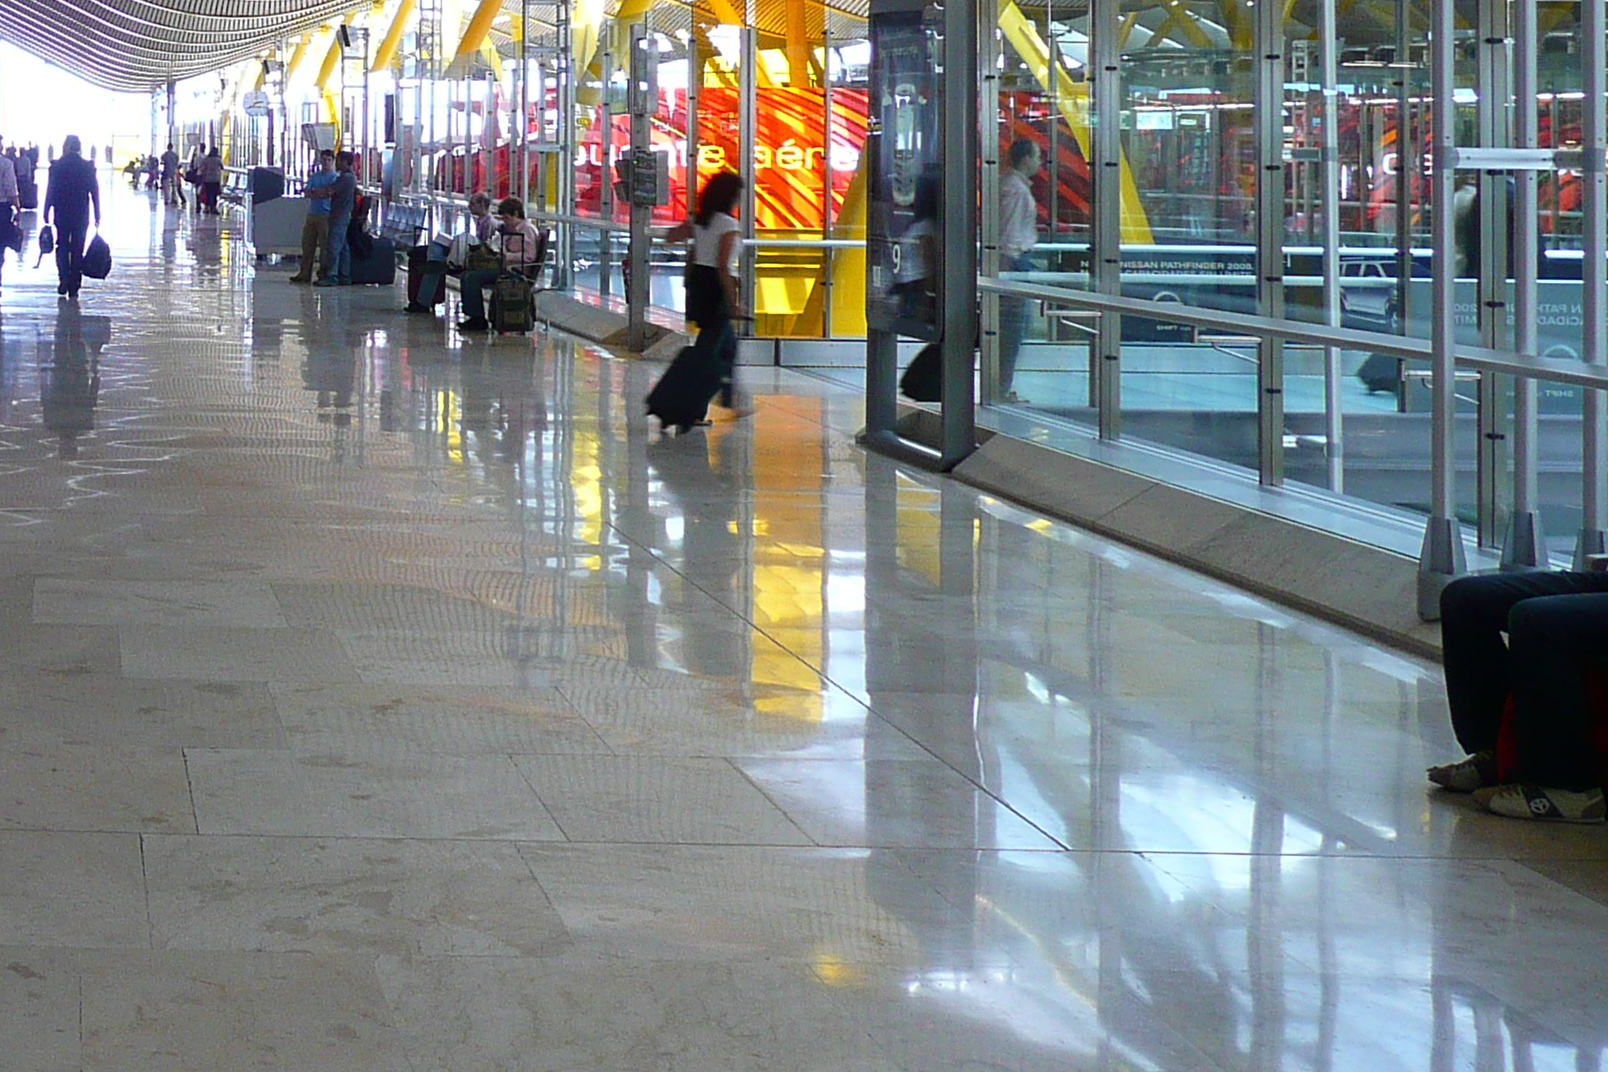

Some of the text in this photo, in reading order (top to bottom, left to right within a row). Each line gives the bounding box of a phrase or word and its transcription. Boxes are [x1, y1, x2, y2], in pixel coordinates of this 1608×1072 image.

[753, 138, 859, 171] aére
[1120, 261, 1158, 269] NISSAN
[1160, 261, 1225, 270] PATHFINDER
